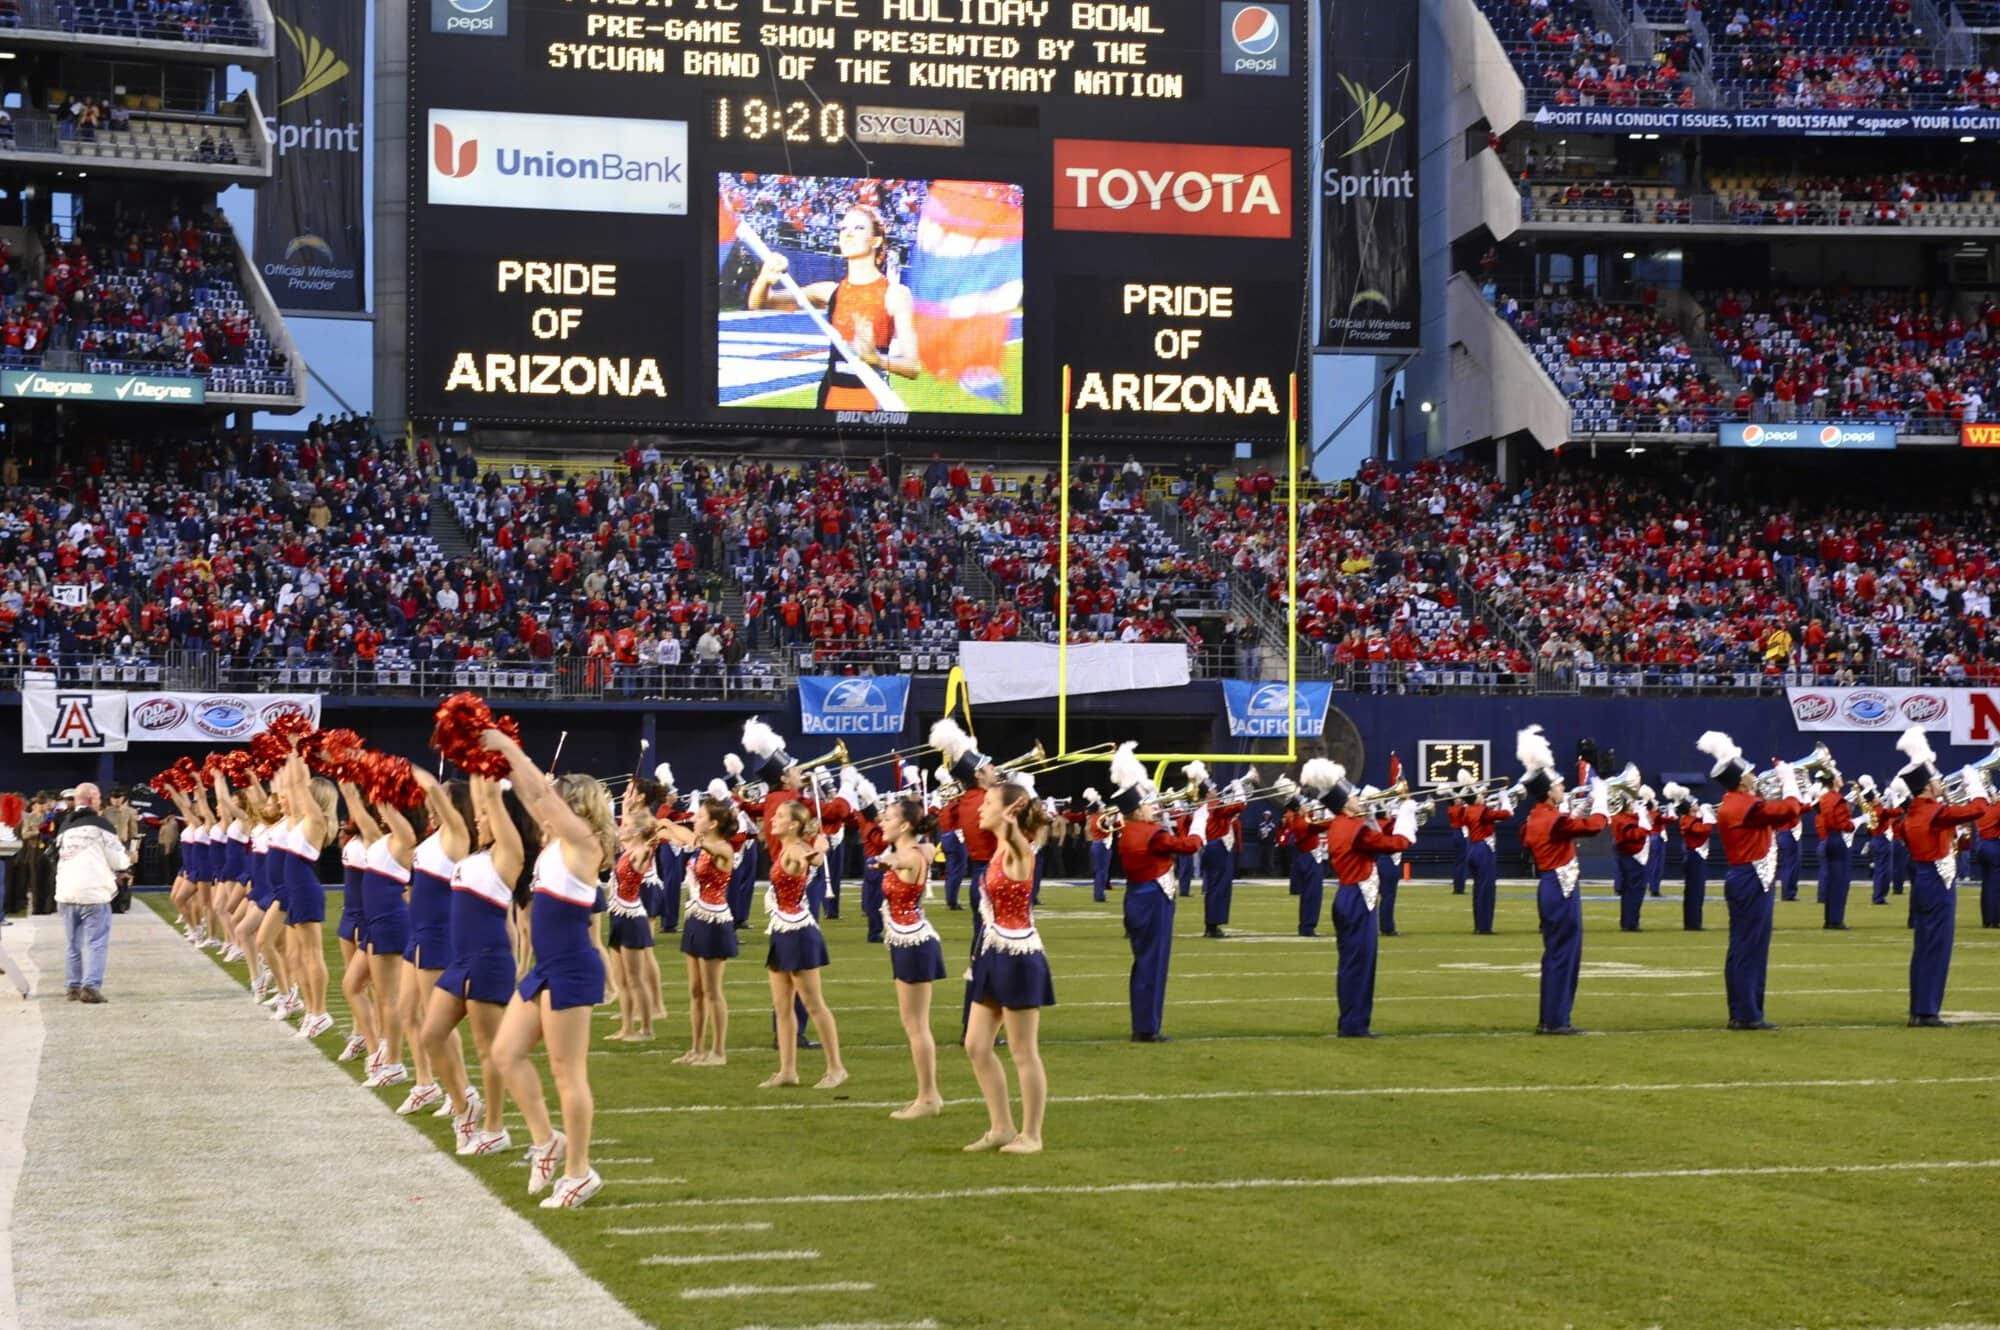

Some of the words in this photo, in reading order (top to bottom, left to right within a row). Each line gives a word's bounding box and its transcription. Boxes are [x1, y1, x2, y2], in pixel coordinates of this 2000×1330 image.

[447, 16, 493, 31] pepsi
[883, 0, 1048, 27] HOLIDAY
[1072, 2, 1165, 33] BOWL
[587, 14, 741, 44] PRE-GAME
[760, 24, 835, 49] SHOW
[853, 29, 1020, 58] PRESENTED
[1038, 38, 1074, 61] BY
[1093, 41, 1146, 65] THE
[548, 42, 665, 72] SYCUAN
[683, 50, 760, 78] BAND
[778, 55, 816, 81] OF
[835, 58, 891, 84] THE
[909, 61, 1056, 92] KUMEYAAY
[1074, 69, 1183, 98] NATION
[1235, 57, 1276, 72] pepsi
[264, 116, 359, 156] Sprint
[718, 98, 845, 143] 19:20
[859, 114, 962, 138] SYCUAN
[1544, 111, 1582, 125] PORT
[1585, 112, 1612, 126] FAN
[1614, 112, 1678, 127] CONDUCT
[1682, 113, 1732, 129] ISSUES,
[1734, 114, 1769, 128] TEXT
[1857, 117, 1908, 131] <space>
[1911, 116, 1950, 129] YOUR
[496, 148, 682, 183] UnionBank
[1066, 167, 1281, 215] TOYOTA
[1324, 168, 1415, 205] Sprint
[264, 263, 305, 277] Official
[308, 265, 354, 279] Wireless
[288, 277, 335, 291] Provider
[498, 261, 616, 296] PRIDE
[1123, 283, 1233, 318] PRIDE
[532, 307, 583, 340] OF
[1328, 317, 1366, 329] Official
[1368, 318, 1411, 330] Wireless
[1349, 329, 1391, 341] Provider
[1154, 328, 1202, 360] OF
[33, 378, 93, 397] Degree
[133, 382, 192, 400] Degree
[445, 352, 667, 397] ARIZONA
[1075, 371, 1280, 414] ARIZONA
[1764, 430, 1798, 442] pepsi
[1842, 430, 1875, 443] pepsi
[47, 694, 105, 748] A
[802, 712, 870, 733] PACIFIC
[1430, 744, 1480, 784] 25
